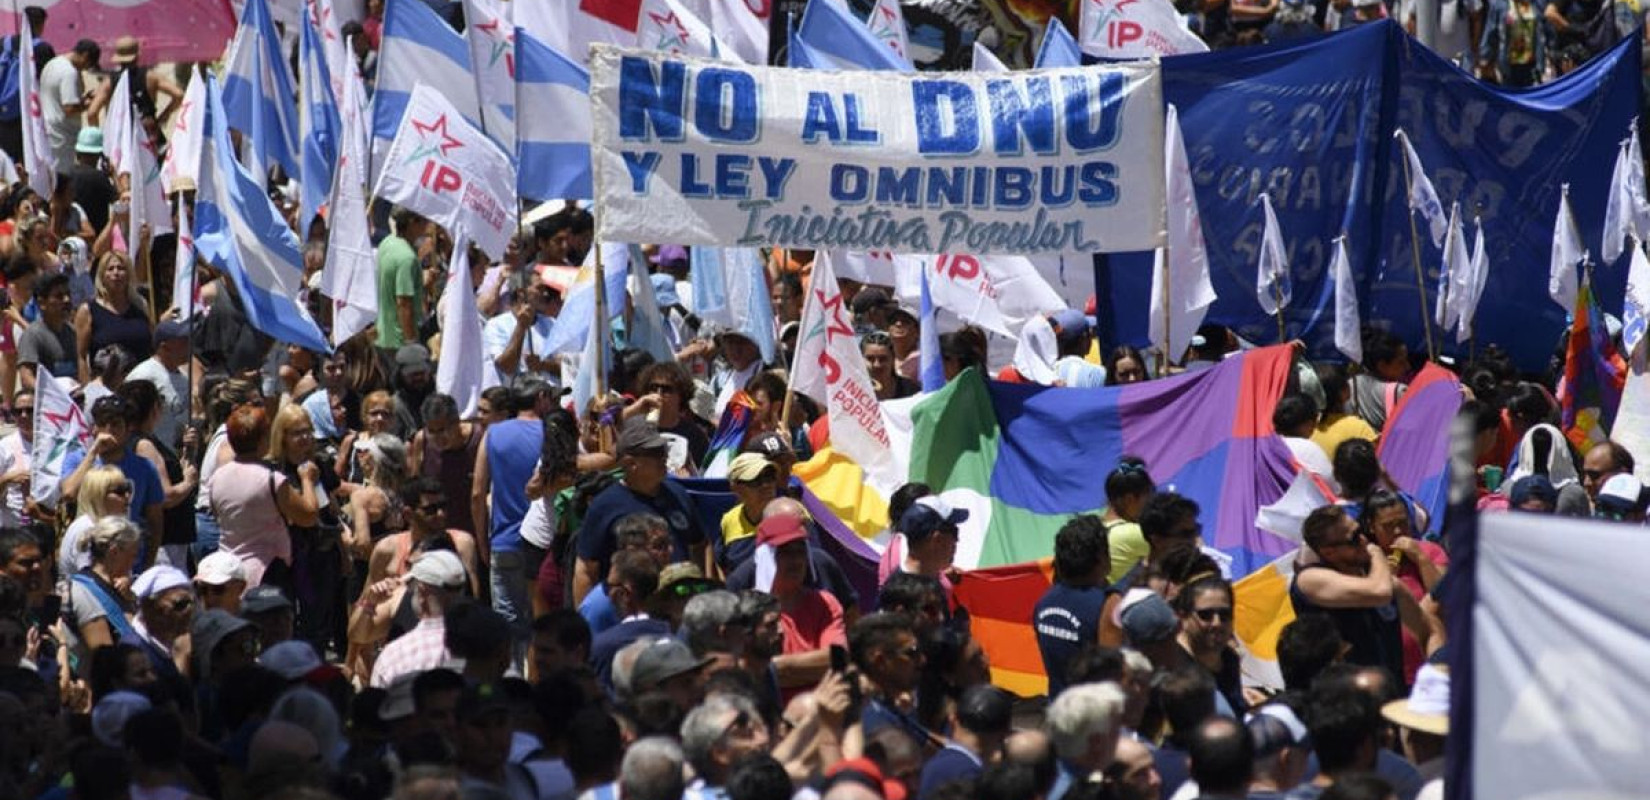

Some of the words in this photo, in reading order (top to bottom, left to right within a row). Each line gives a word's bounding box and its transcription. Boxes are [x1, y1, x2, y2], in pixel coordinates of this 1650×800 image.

[1108, 21, 1144, 48] IP
[619, 56, 761, 144] NO
[802, 91, 883, 145] AL
[912, 72, 1126, 156] DNU
[421, 160, 462, 194] IP
[620, 151, 661, 196] Y
[680, 153, 797, 200] LEY
[829, 161, 1119, 211] OMNIBUS
[737, 200, 932, 251] Iniciativa
[937, 207, 1100, 253] Popular
[936, 253, 980, 281] IP
